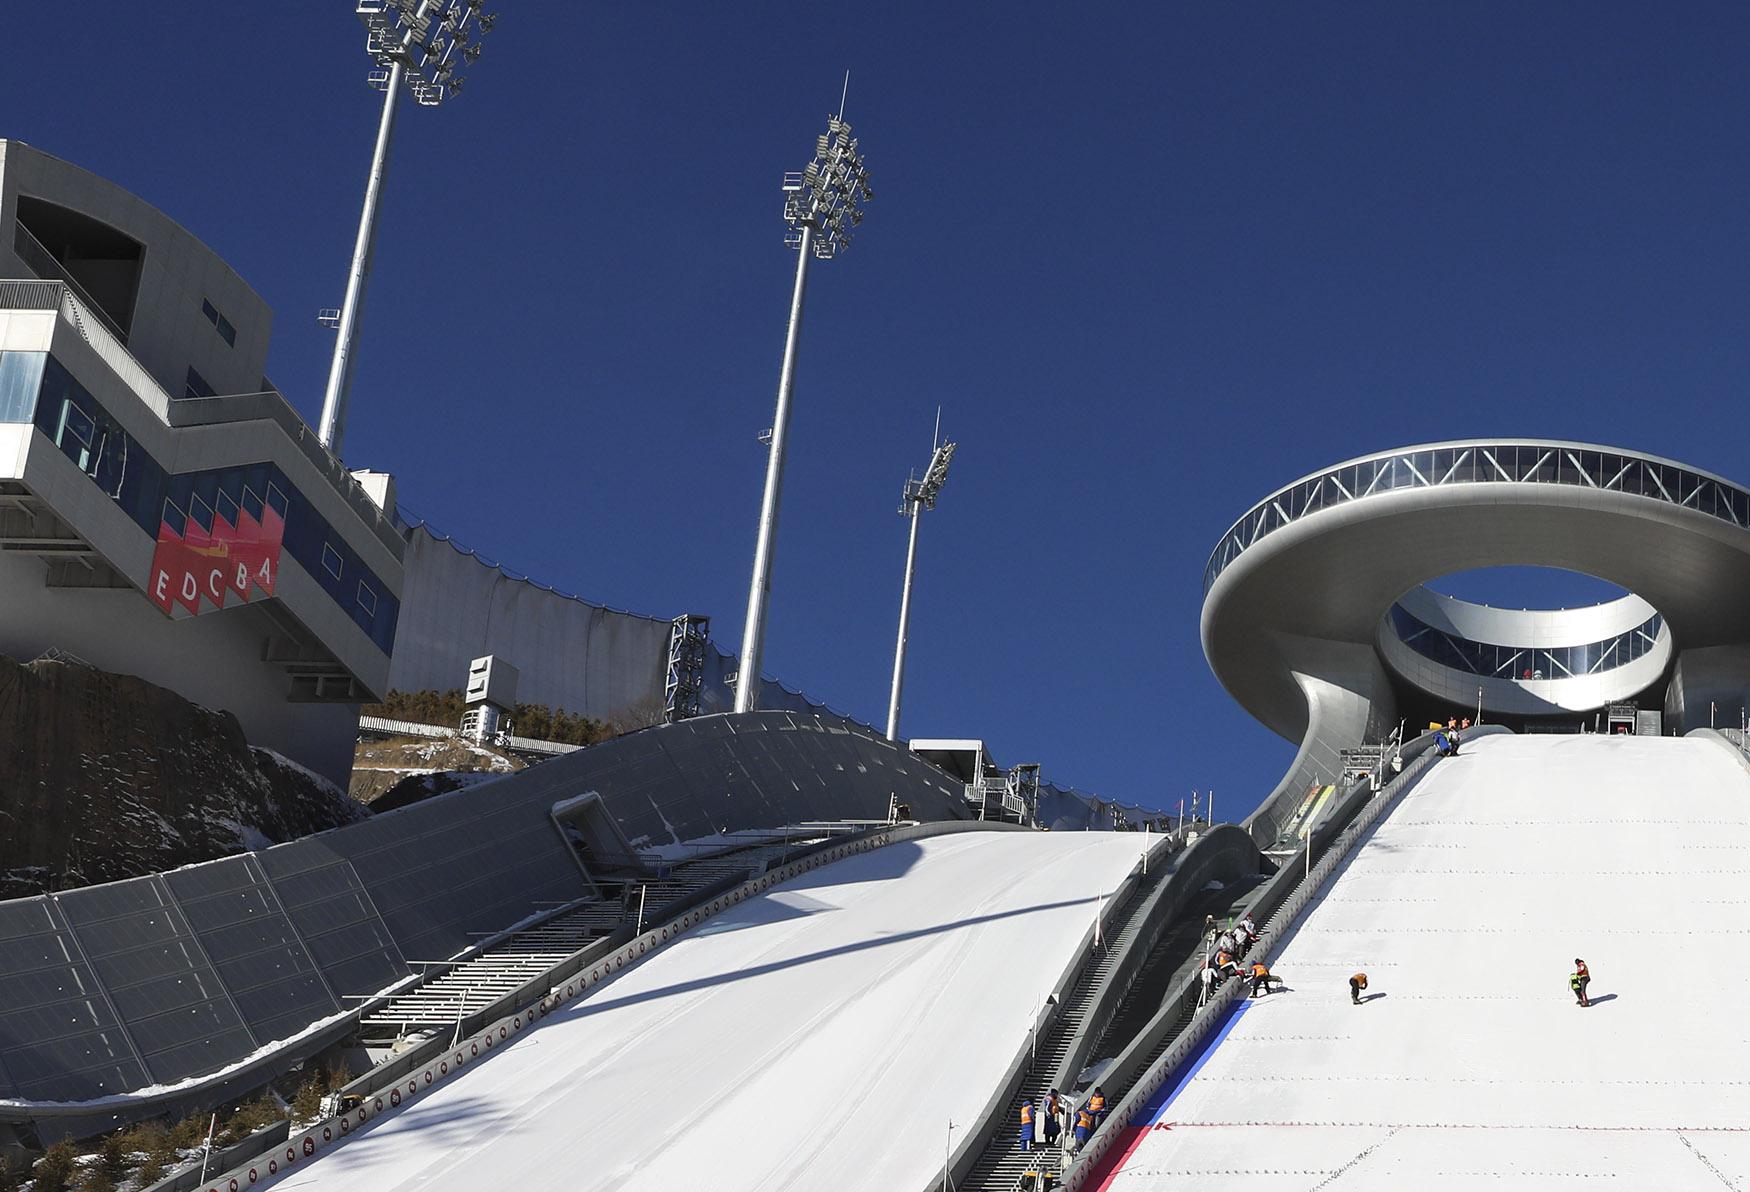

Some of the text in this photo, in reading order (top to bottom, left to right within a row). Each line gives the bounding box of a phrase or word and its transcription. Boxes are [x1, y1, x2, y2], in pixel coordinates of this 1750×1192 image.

[156, 557, 270, 601] E D C B A
